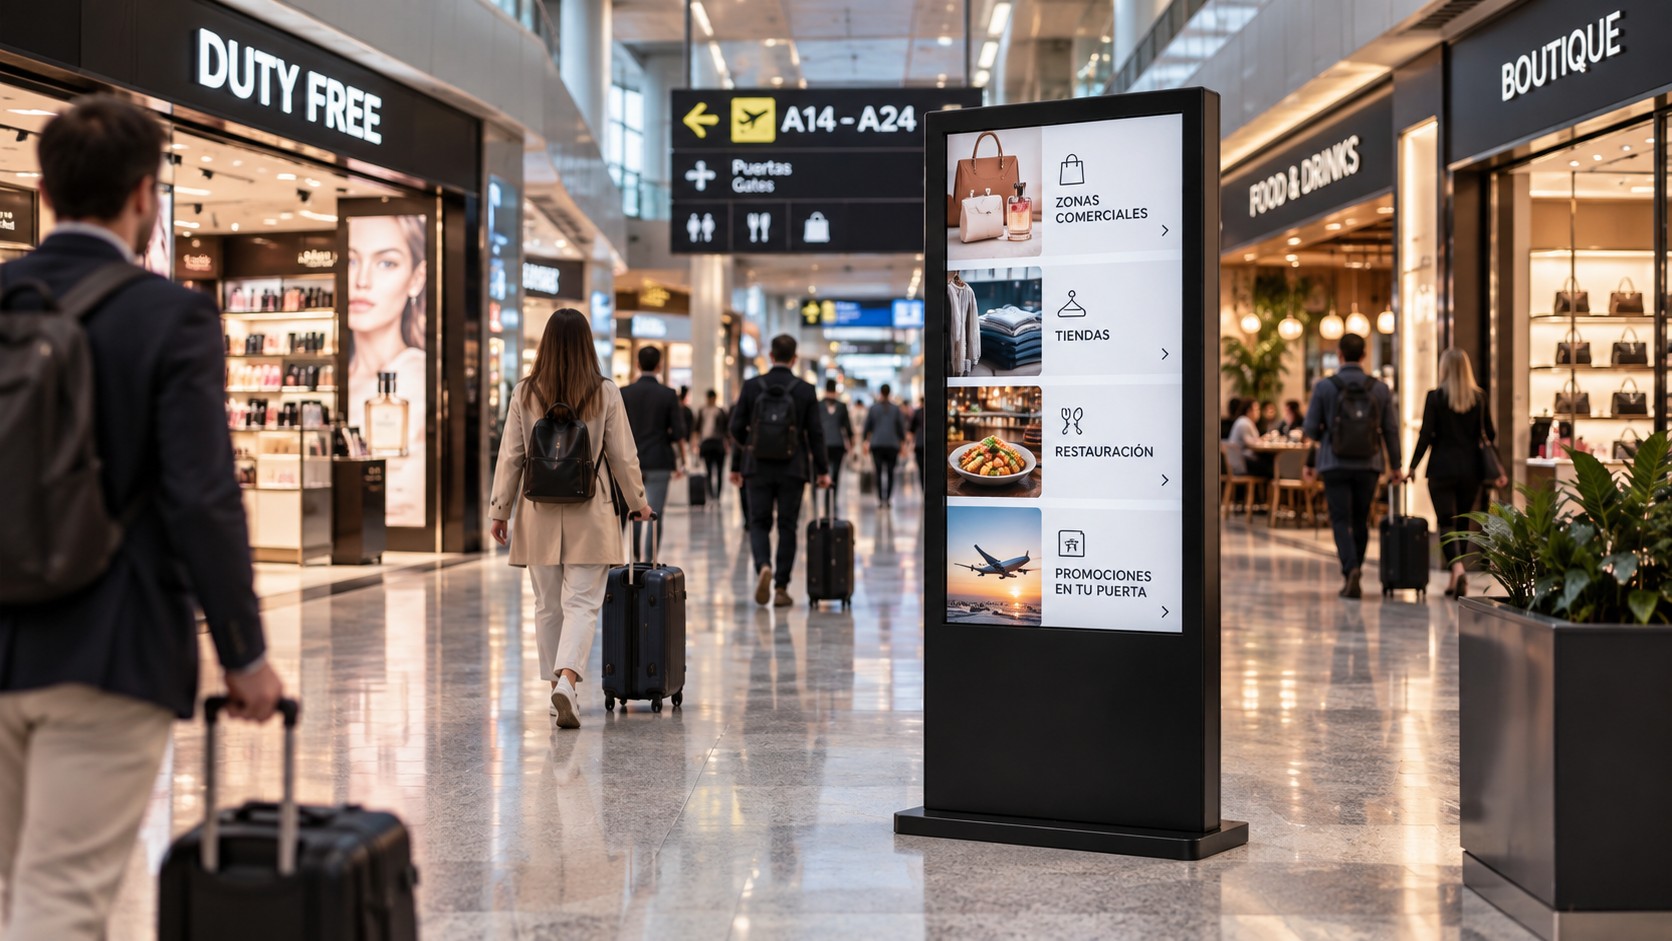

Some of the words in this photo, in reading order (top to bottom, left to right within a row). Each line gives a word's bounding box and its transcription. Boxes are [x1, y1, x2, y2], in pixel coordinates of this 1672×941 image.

[1502, 11, 1622, 102] BOUTIQUE
[198, 27, 300, 114] DUTY
[306, 70, 382, 146] FREE
[781, 106, 836, 133] A14
[857, 105, 917, 133] A24
[732, 158, 793, 176] Puertas
[732, 176, 775, 193] Gates
[1249, 171, 1287, 218] FOOD
[1287, 165, 1301, 201] &
[1301, 134, 1361, 194] DRINKS
[1055, 194, 1100, 208] ZONAS
[1055, 207, 1148, 224] COMERCIALES
[1055, 329, 1110, 342] TIENDAS
[1055, 443, 1154, 458] RESTAURACIÓN
[1055, 568, 1152, 582] PROMOCIONES
[1055, 583, 1072, 595] EN
[1075, 584, 1093, 596] TU
[1096, 585, 1148, 598] PUERTA
